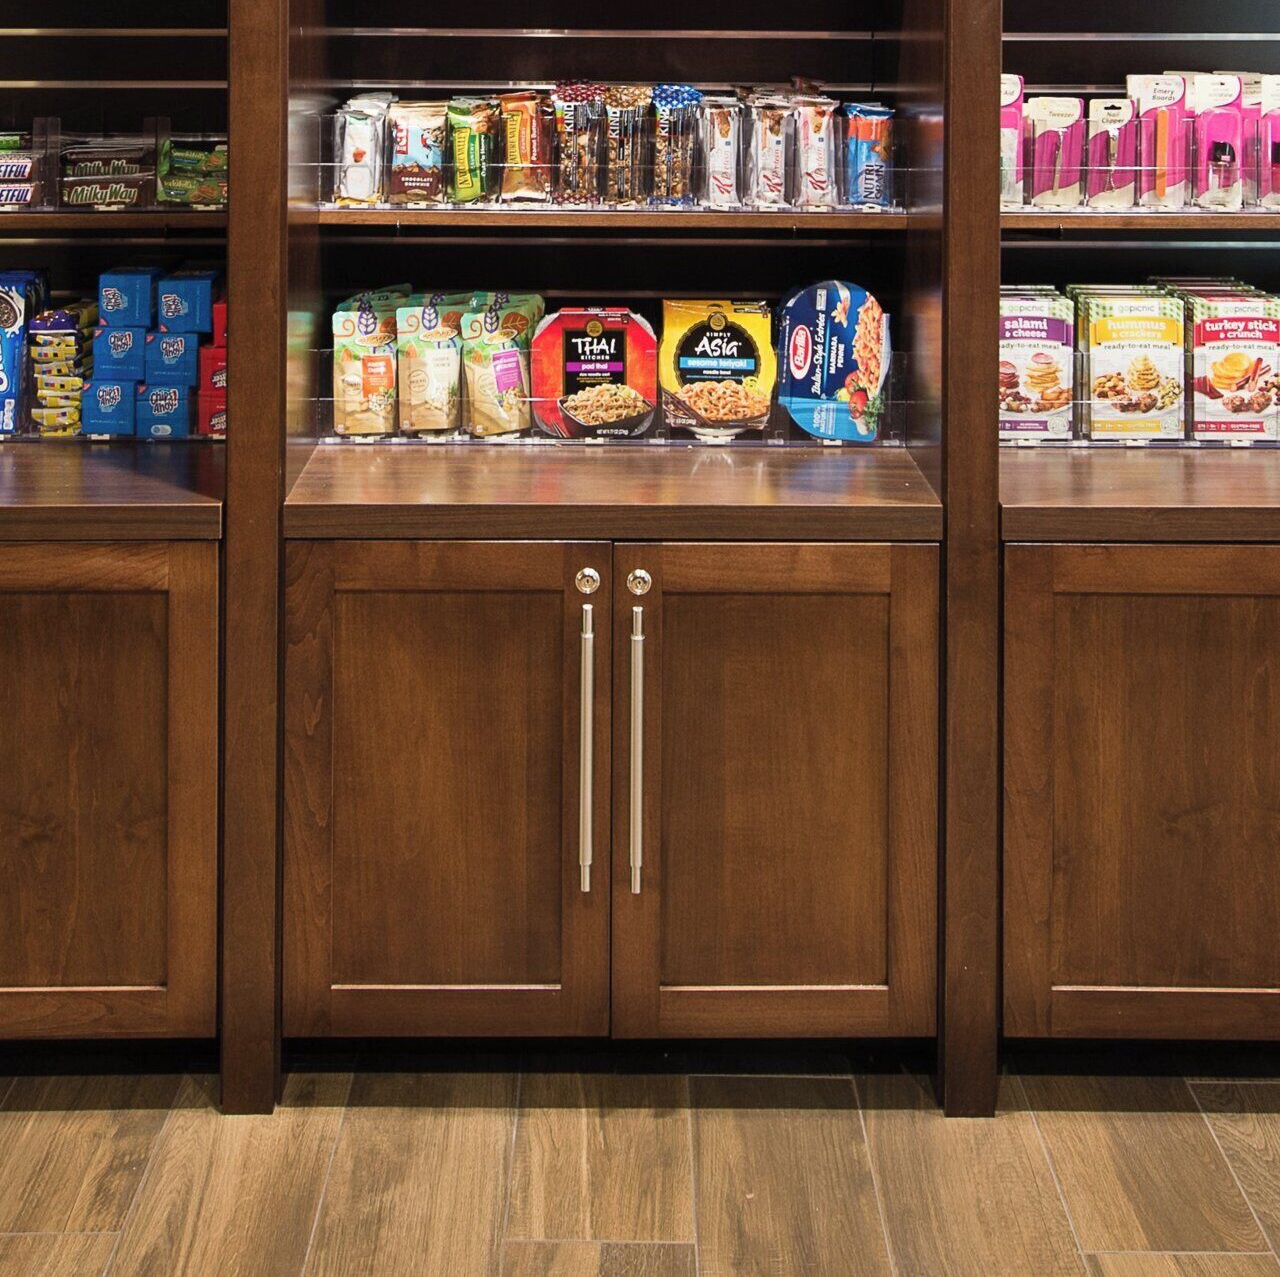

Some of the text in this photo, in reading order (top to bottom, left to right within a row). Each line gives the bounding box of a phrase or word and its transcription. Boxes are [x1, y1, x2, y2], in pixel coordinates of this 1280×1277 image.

[1153, 88, 1175, 96] Emery
[564, 104, 574, 132] KIND
[609, 110, 620, 138] KIND
[659, 107, 670, 136] KIND
[454, 129, 469, 187] NATURE VALLEY
[711, 175, 734, 195] K
[762, 174, 784, 193] K
[805, 171, 827, 191] K
[863, 164, 875, 200] NUTRI
[1008, 304, 1045, 313] gopicnic
[1118, 304, 1155, 313] gopicnic
[1222, 305, 1260, 314] gopicnic
[1004, 318, 1048, 330] salami
[1107, 319, 1167, 331] hummus
[1205, 319, 1277, 332] turkey stick
[1012, 329, 1048, 339] cheese
[1226, 329, 1263, 339] crunch
[572, 337, 616, 356] THAI
[694, 336, 739, 358] Asia
[793, 329, 808, 367] Barilla
[829, 335, 838, 374] MARINARA
[837, 343, 845, 368] PENNE
[581, 362, 608, 371] pad thai
[687, 358, 748, 369] sesame teriyaki
[811, 341, 826, 395] Italian-Style
